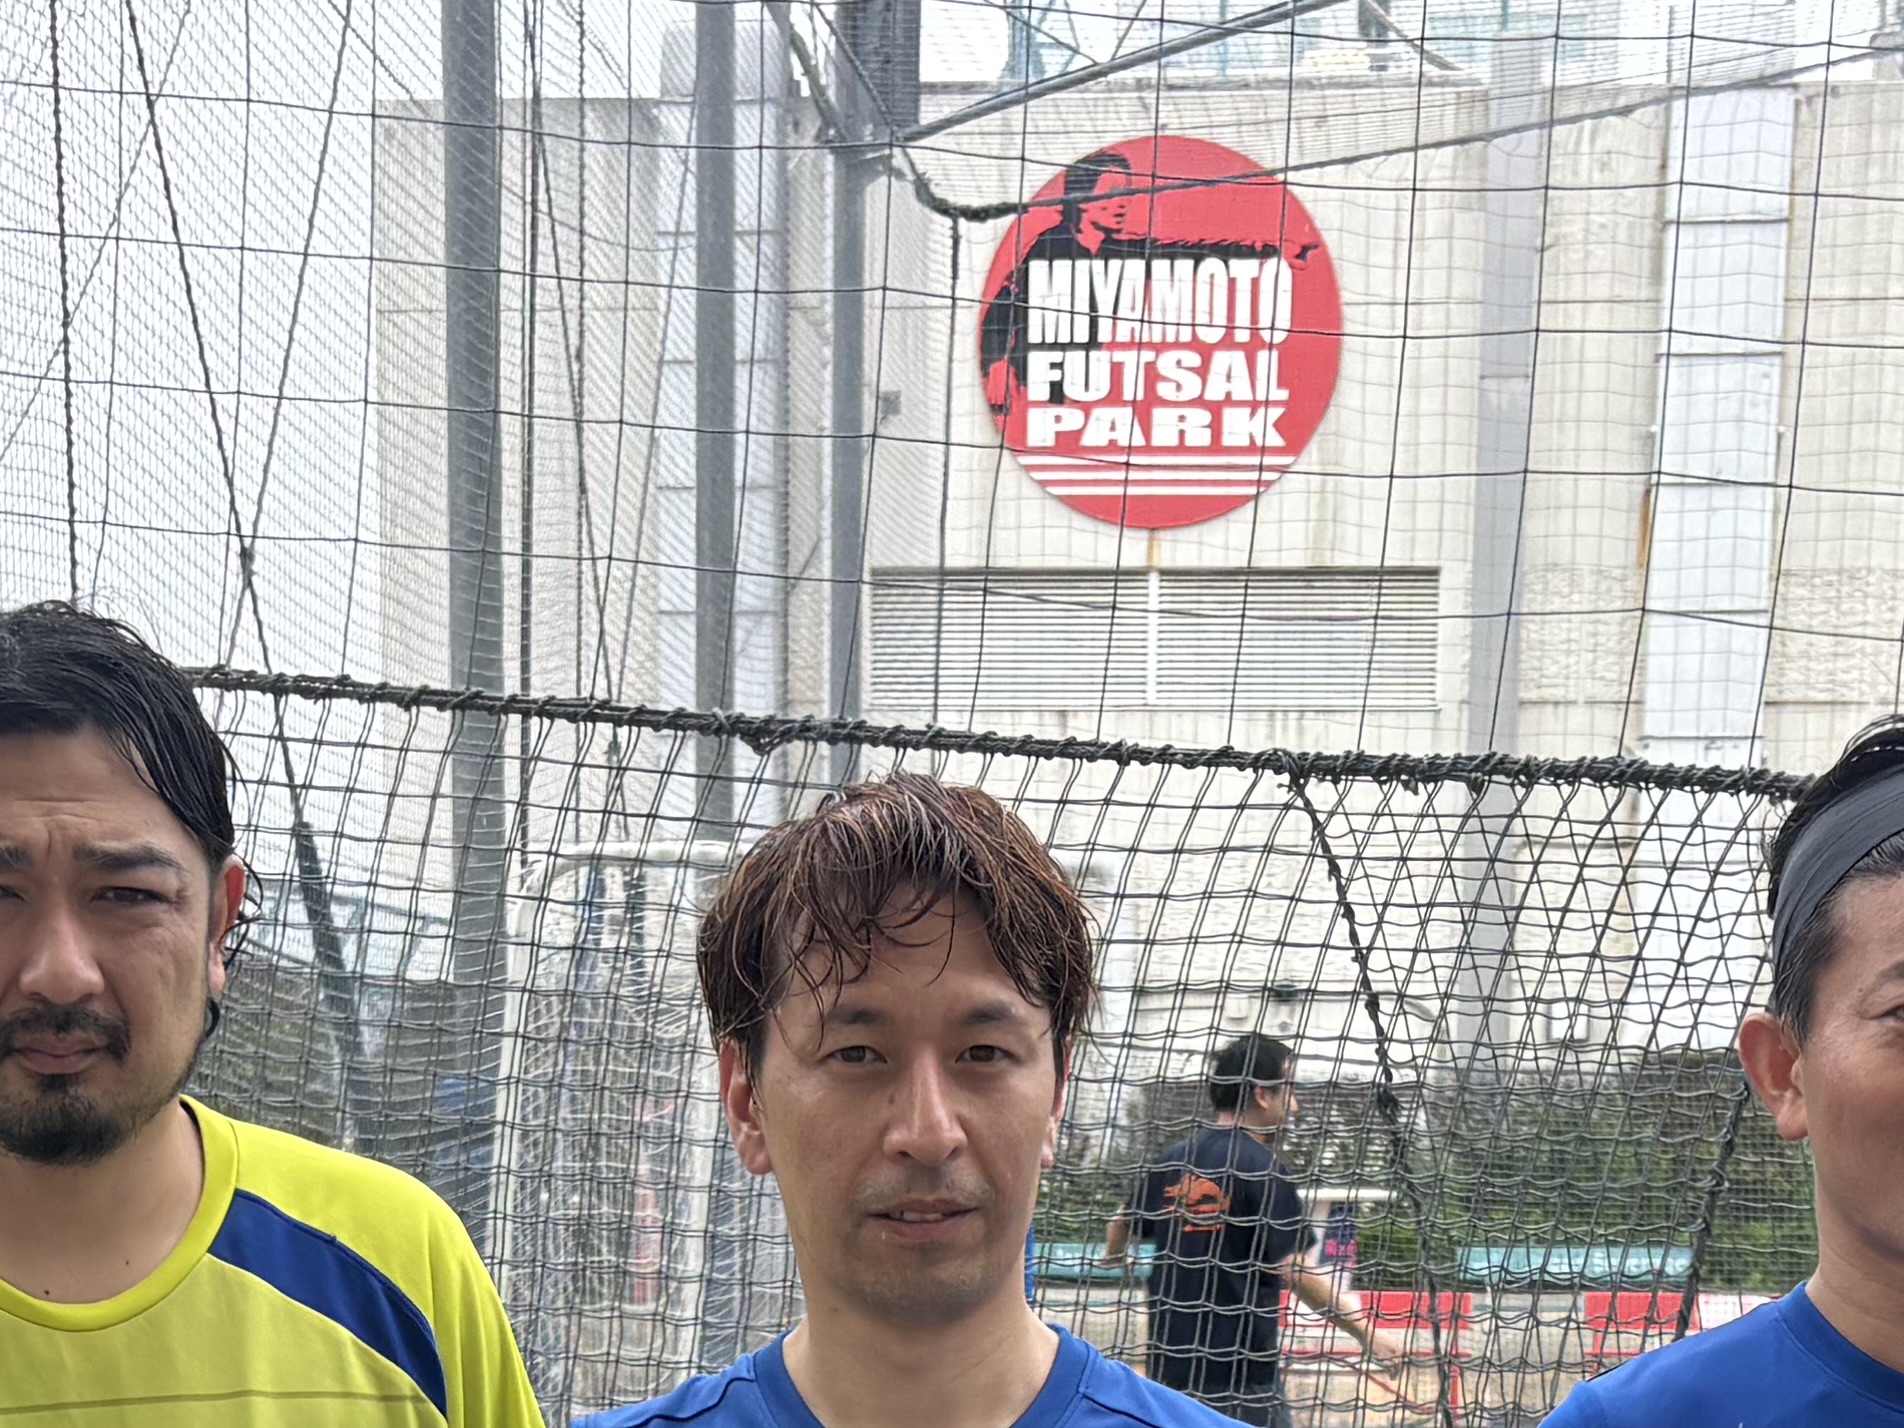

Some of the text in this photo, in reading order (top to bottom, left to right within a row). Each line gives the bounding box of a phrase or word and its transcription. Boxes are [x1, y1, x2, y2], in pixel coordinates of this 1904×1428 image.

[1027, 257, 1293, 344] MIYAMOTO
[1026, 350, 1290, 401] FUTSAL
[1026, 407, 1287, 448] PARK
